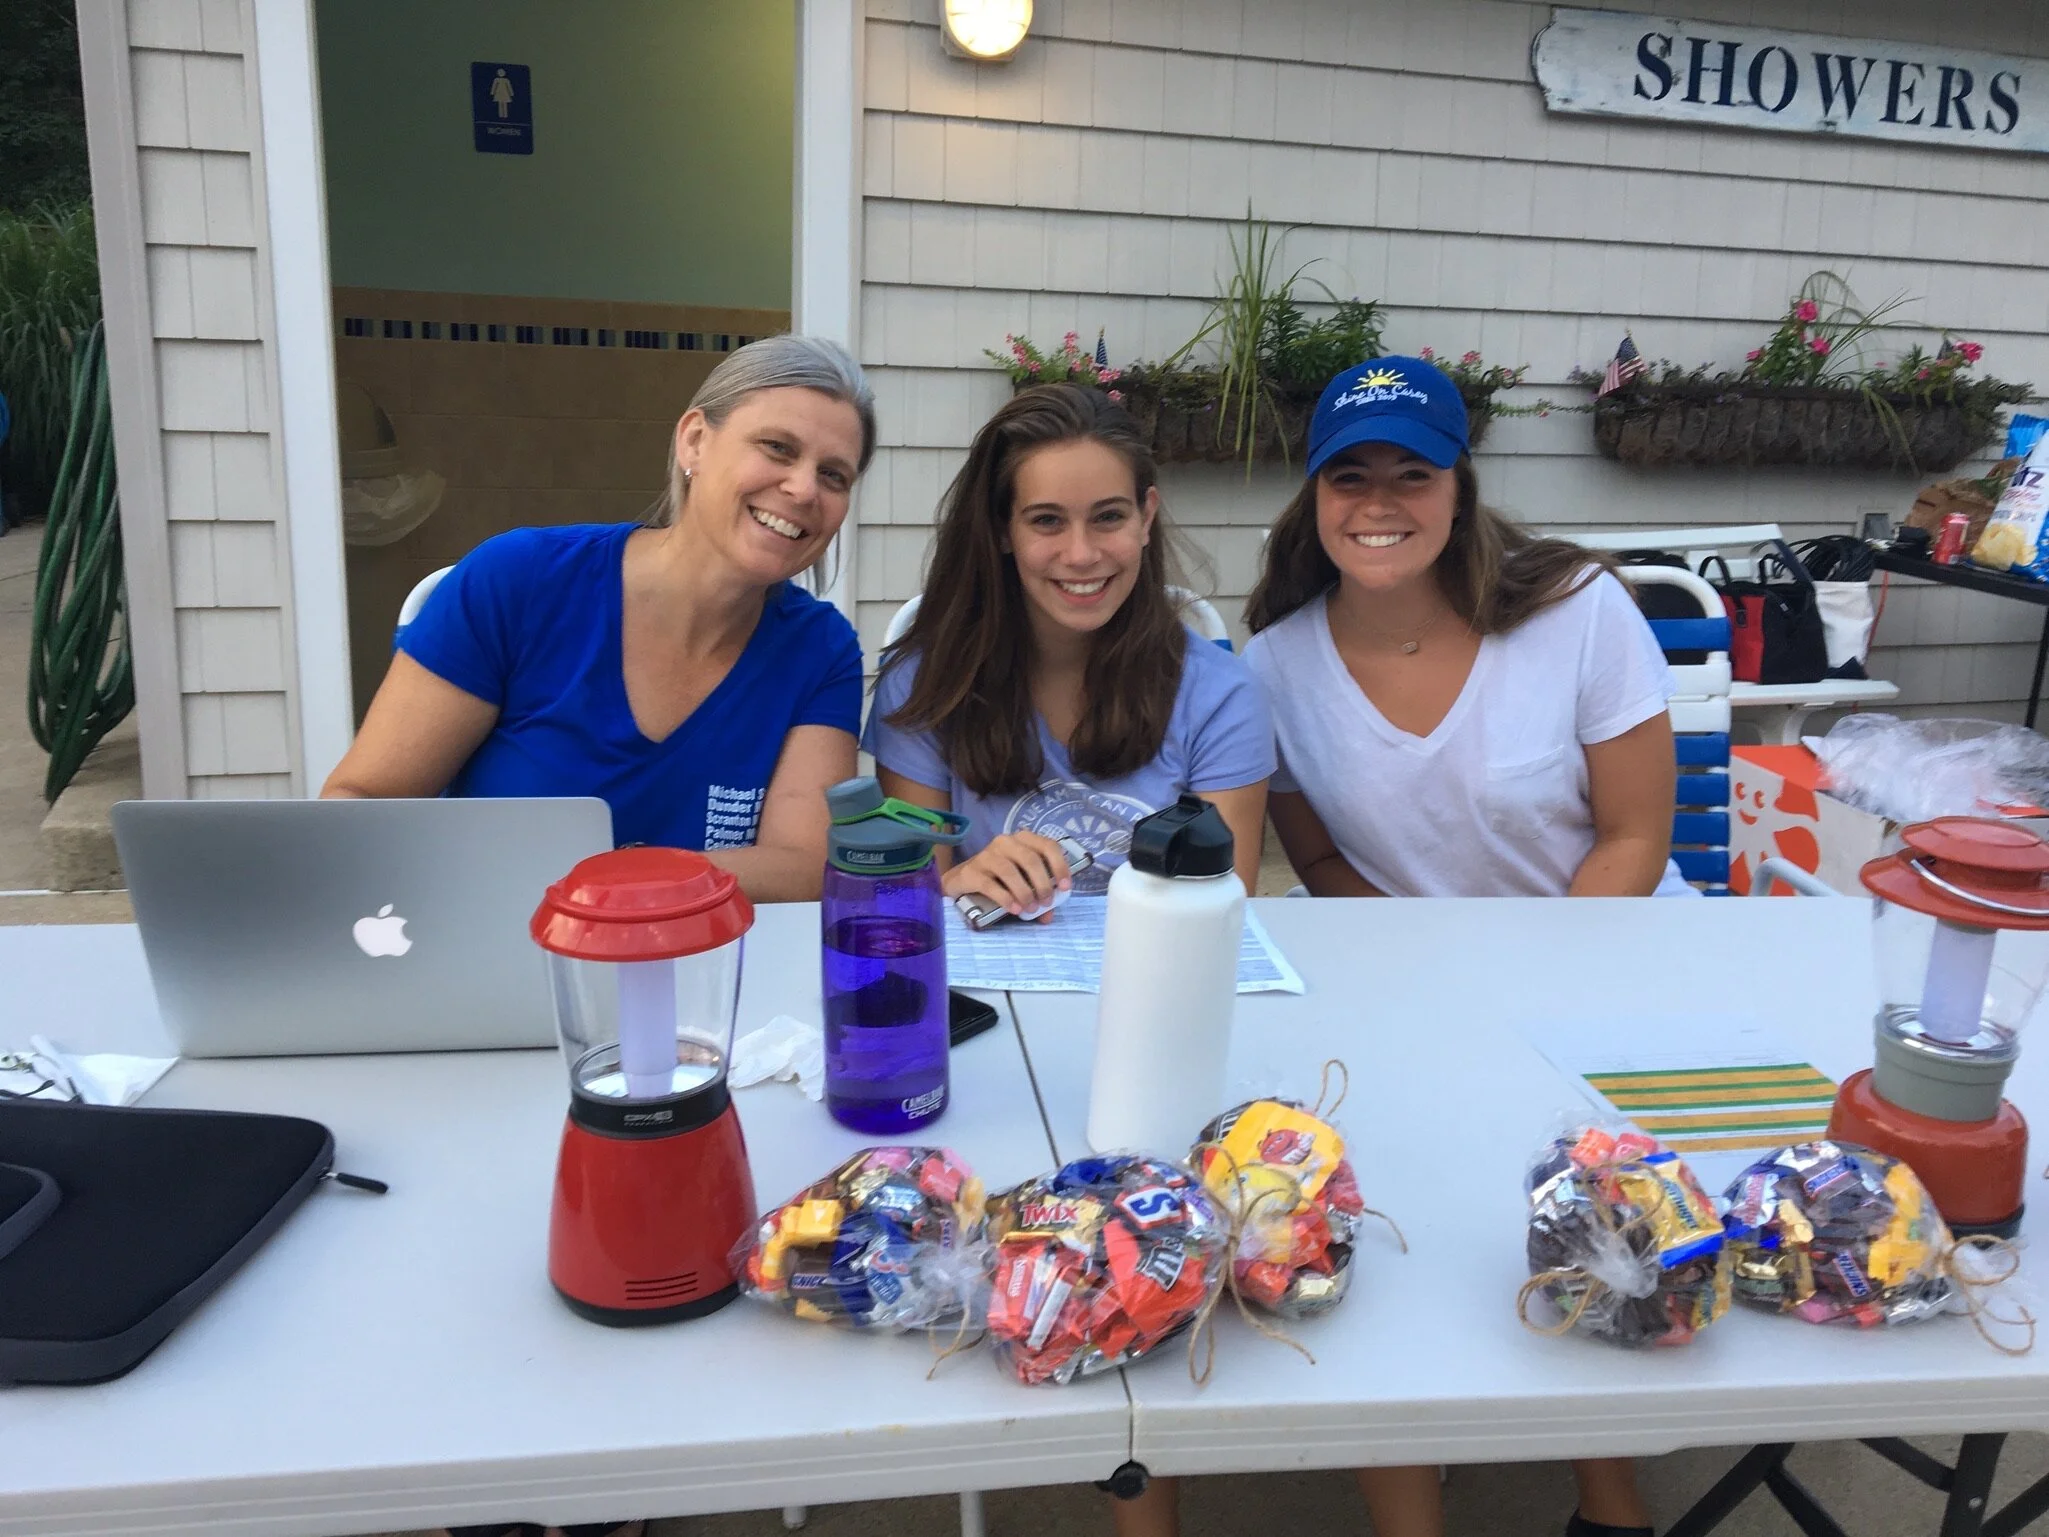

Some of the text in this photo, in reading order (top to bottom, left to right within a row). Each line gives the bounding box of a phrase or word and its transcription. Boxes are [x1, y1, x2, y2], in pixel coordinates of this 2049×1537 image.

[1634, 31, 2021, 136] SHOWERS
[1367, 385, 1389, 397] On
[708, 785, 756, 800] Michael
[707, 798, 753, 814] Dunder
[706, 811, 751, 827] Scranton
[705, 825, 745, 841] Palmer
